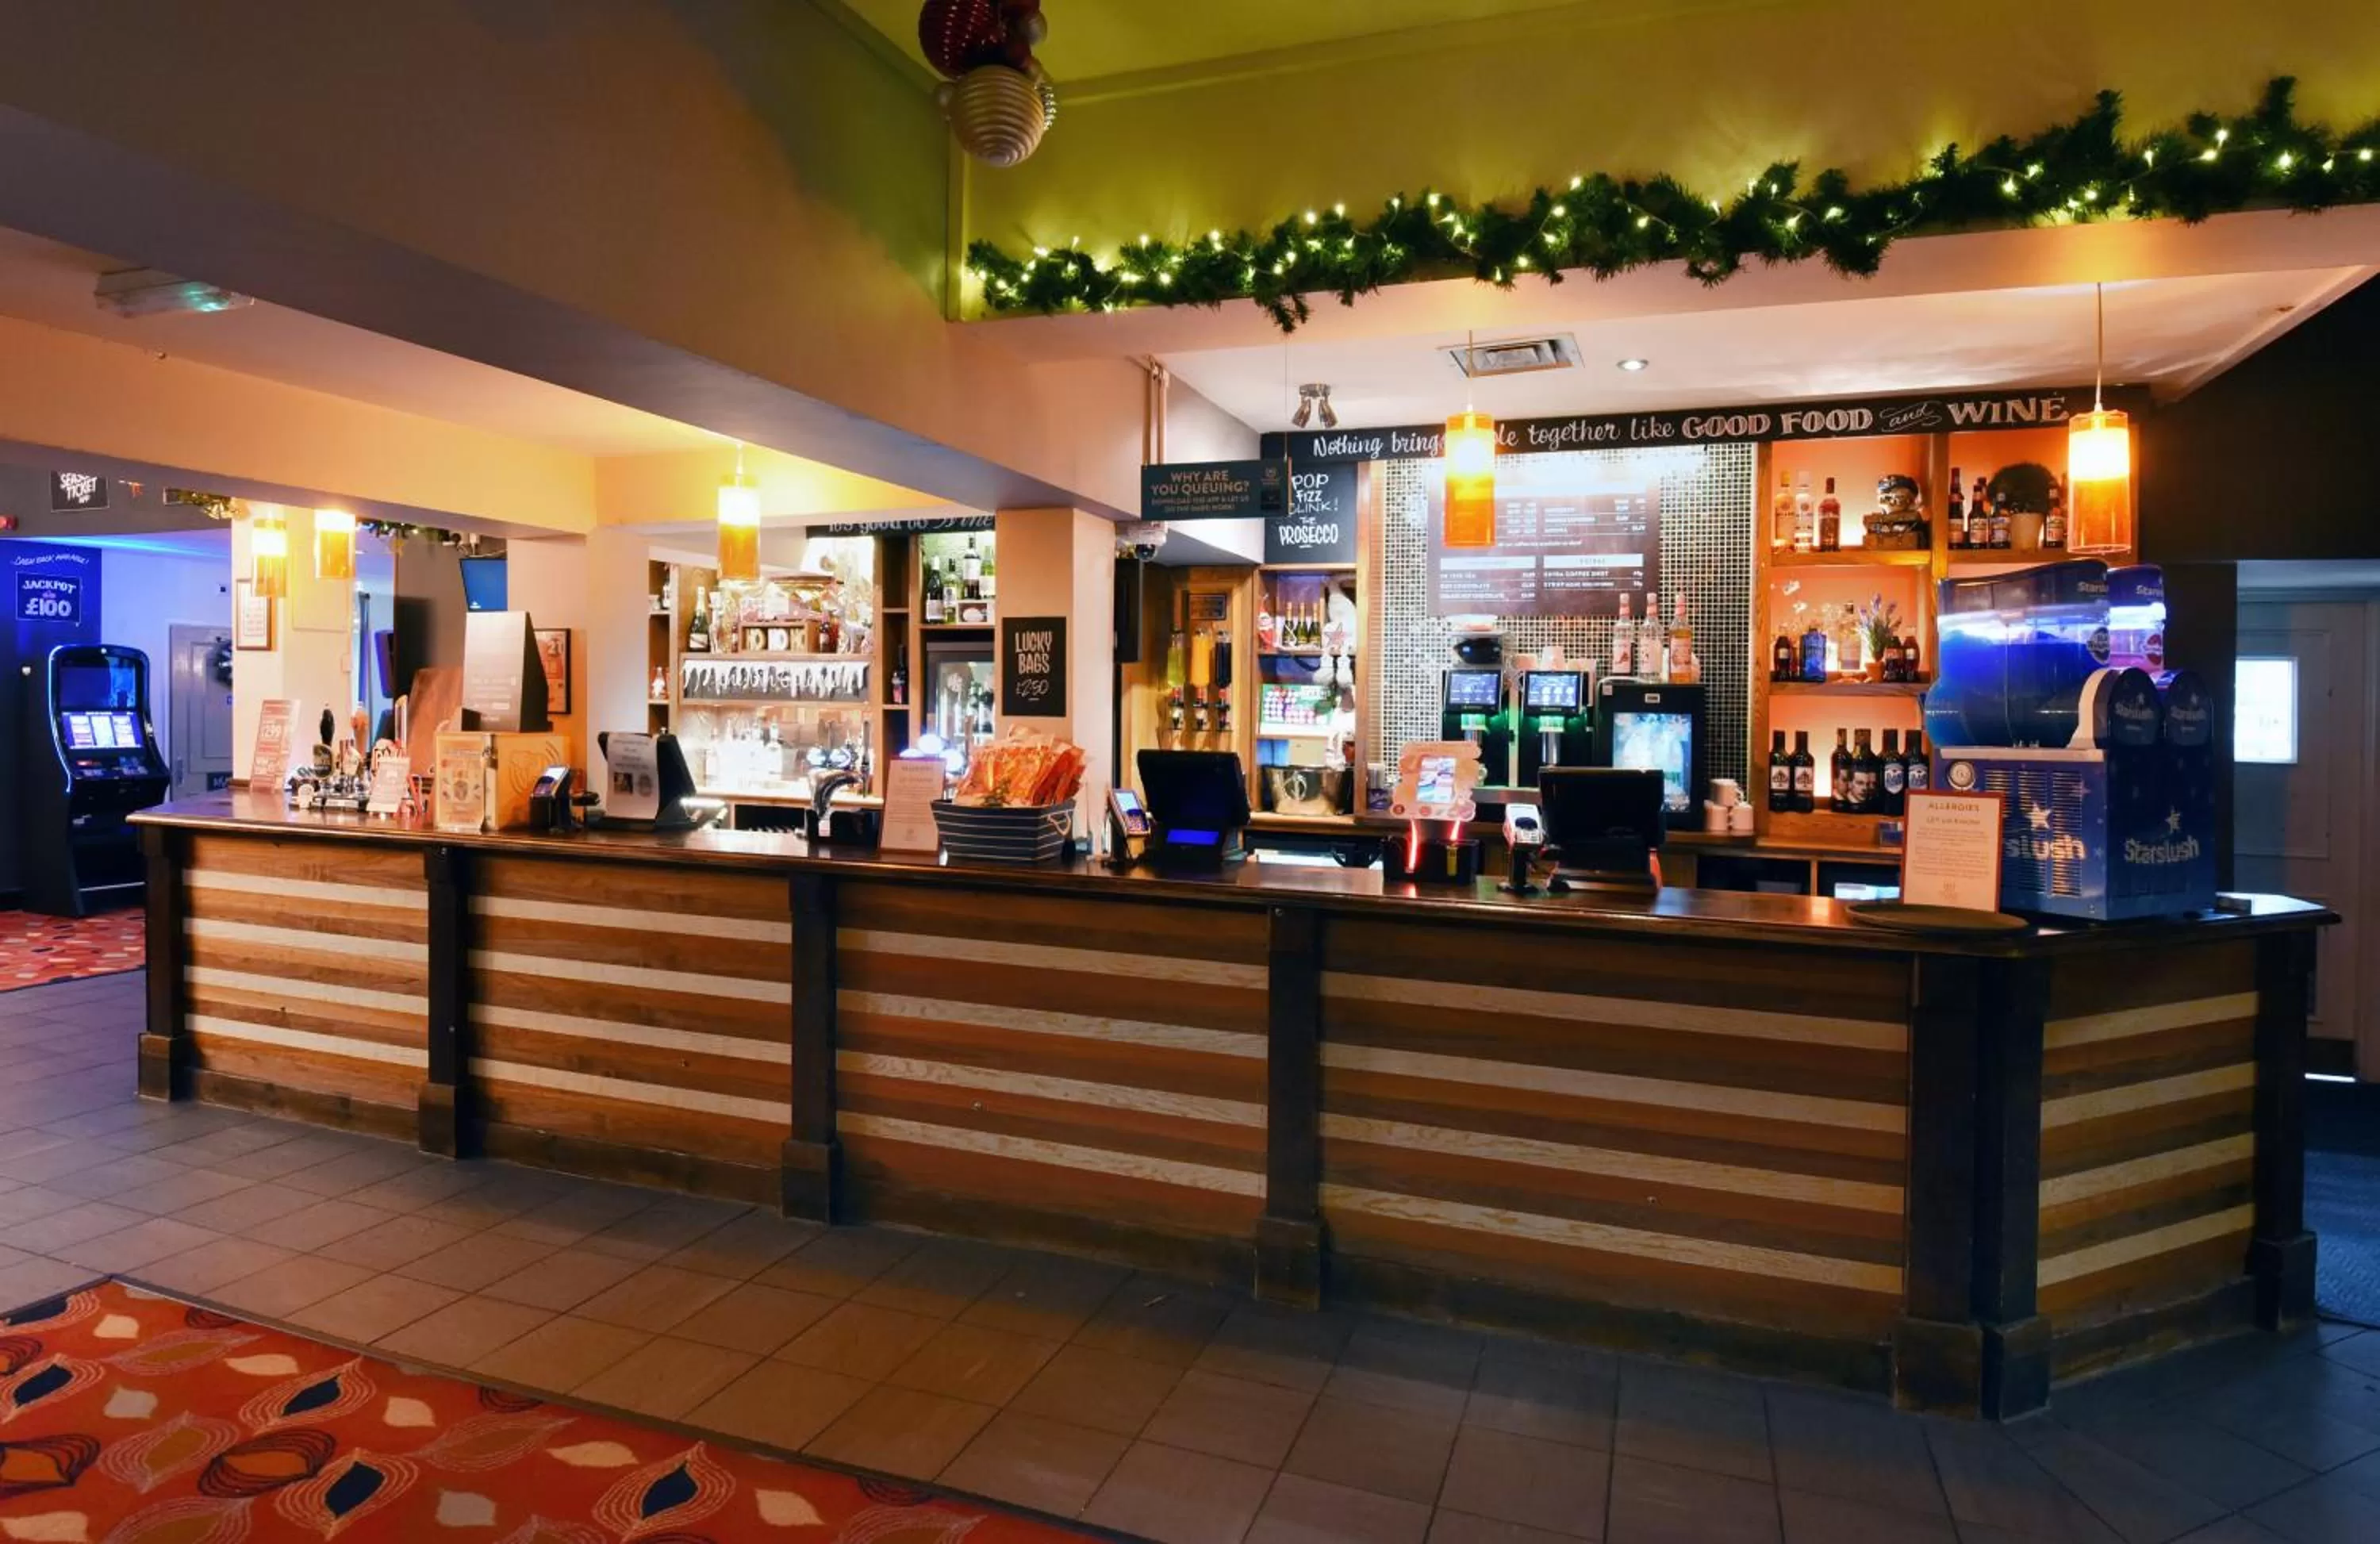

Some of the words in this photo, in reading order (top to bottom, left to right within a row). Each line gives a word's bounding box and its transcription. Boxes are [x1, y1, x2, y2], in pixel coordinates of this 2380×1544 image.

[1313, 434, 1383, 459] Nothing
[1391, 431, 1445, 457] bring
[1528, 417, 1620, 450] together
[1630, 414, 1674, 440] like
[1682, 412, 1770, 438] GOOD
[1781, 409, 1872, 435] FOOD
[1883, 401, 1937, 432] and
[1948, 397, 2069, 425] WINE
[1170, 471, 1200, 483] WHY
[1203, 470, 1229, 482] ARE
[1292, 473, 1329, 490] POP
[1151, 483, 1178, 496] YOU
[1182, 480, 1250, 495] QUEUING?
[1296, 490, 1322, 502] FIZZ
[1279, 524, 1338, 546] PROSECCO
[22, 580, 76, 594] JACKPOT
[25, 597, 72, 616] £100
[1015, 631, 1054, 652] LUCKY
[1018, 653, 1050, 674] BAGS
[2005, 835, 2086, 861] slush
[2124, 834, 2200, 864] Starslush
